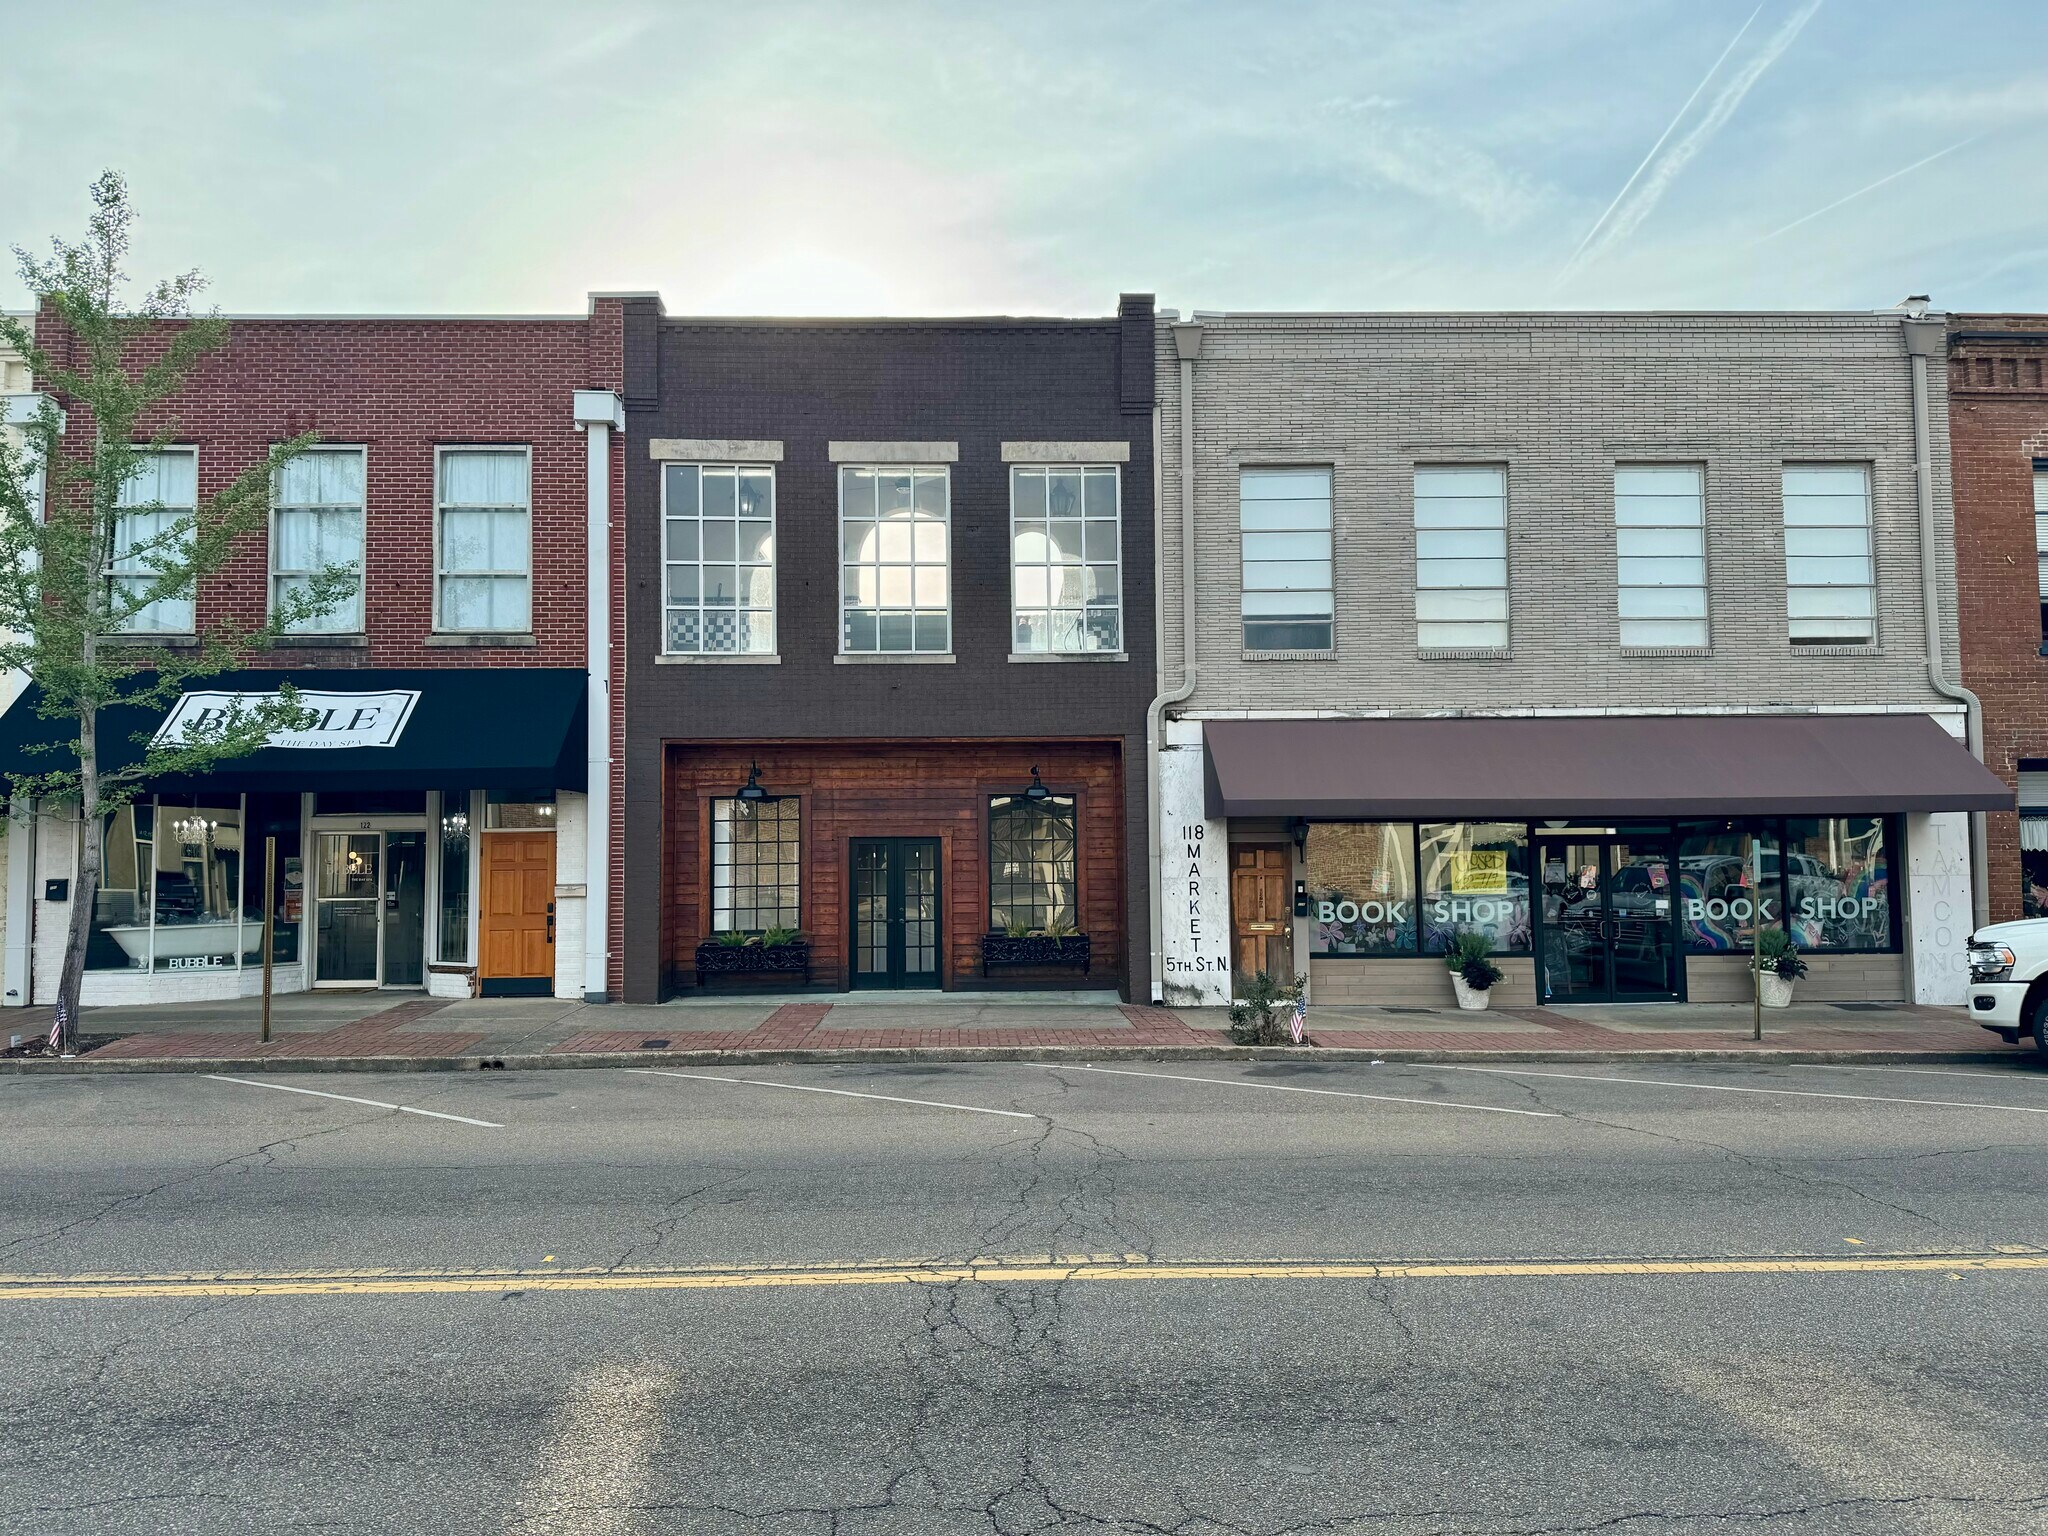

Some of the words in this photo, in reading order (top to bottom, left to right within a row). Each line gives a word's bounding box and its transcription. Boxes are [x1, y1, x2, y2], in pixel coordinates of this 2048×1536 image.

[280, 739, 305, 747] THE
[309, 740, 333, 748] DAY
[339, 739, 362, 747] SPA
[360, 821, 371, 829] 122
[1183, 824, 1204, 840] 118
[1929, 824, 1952, 947] TAMCO
[1187, 843, 1202, 953] MARKET
[1318, 901, 1406, 923] BOOK
[1434, 900, 1514, 923] SHOP
[1688, 898, 1775, 920] BOOK
[1800, 897, 1878, 919] SHOP
[168, 955, 223, 969] BUBBLE
